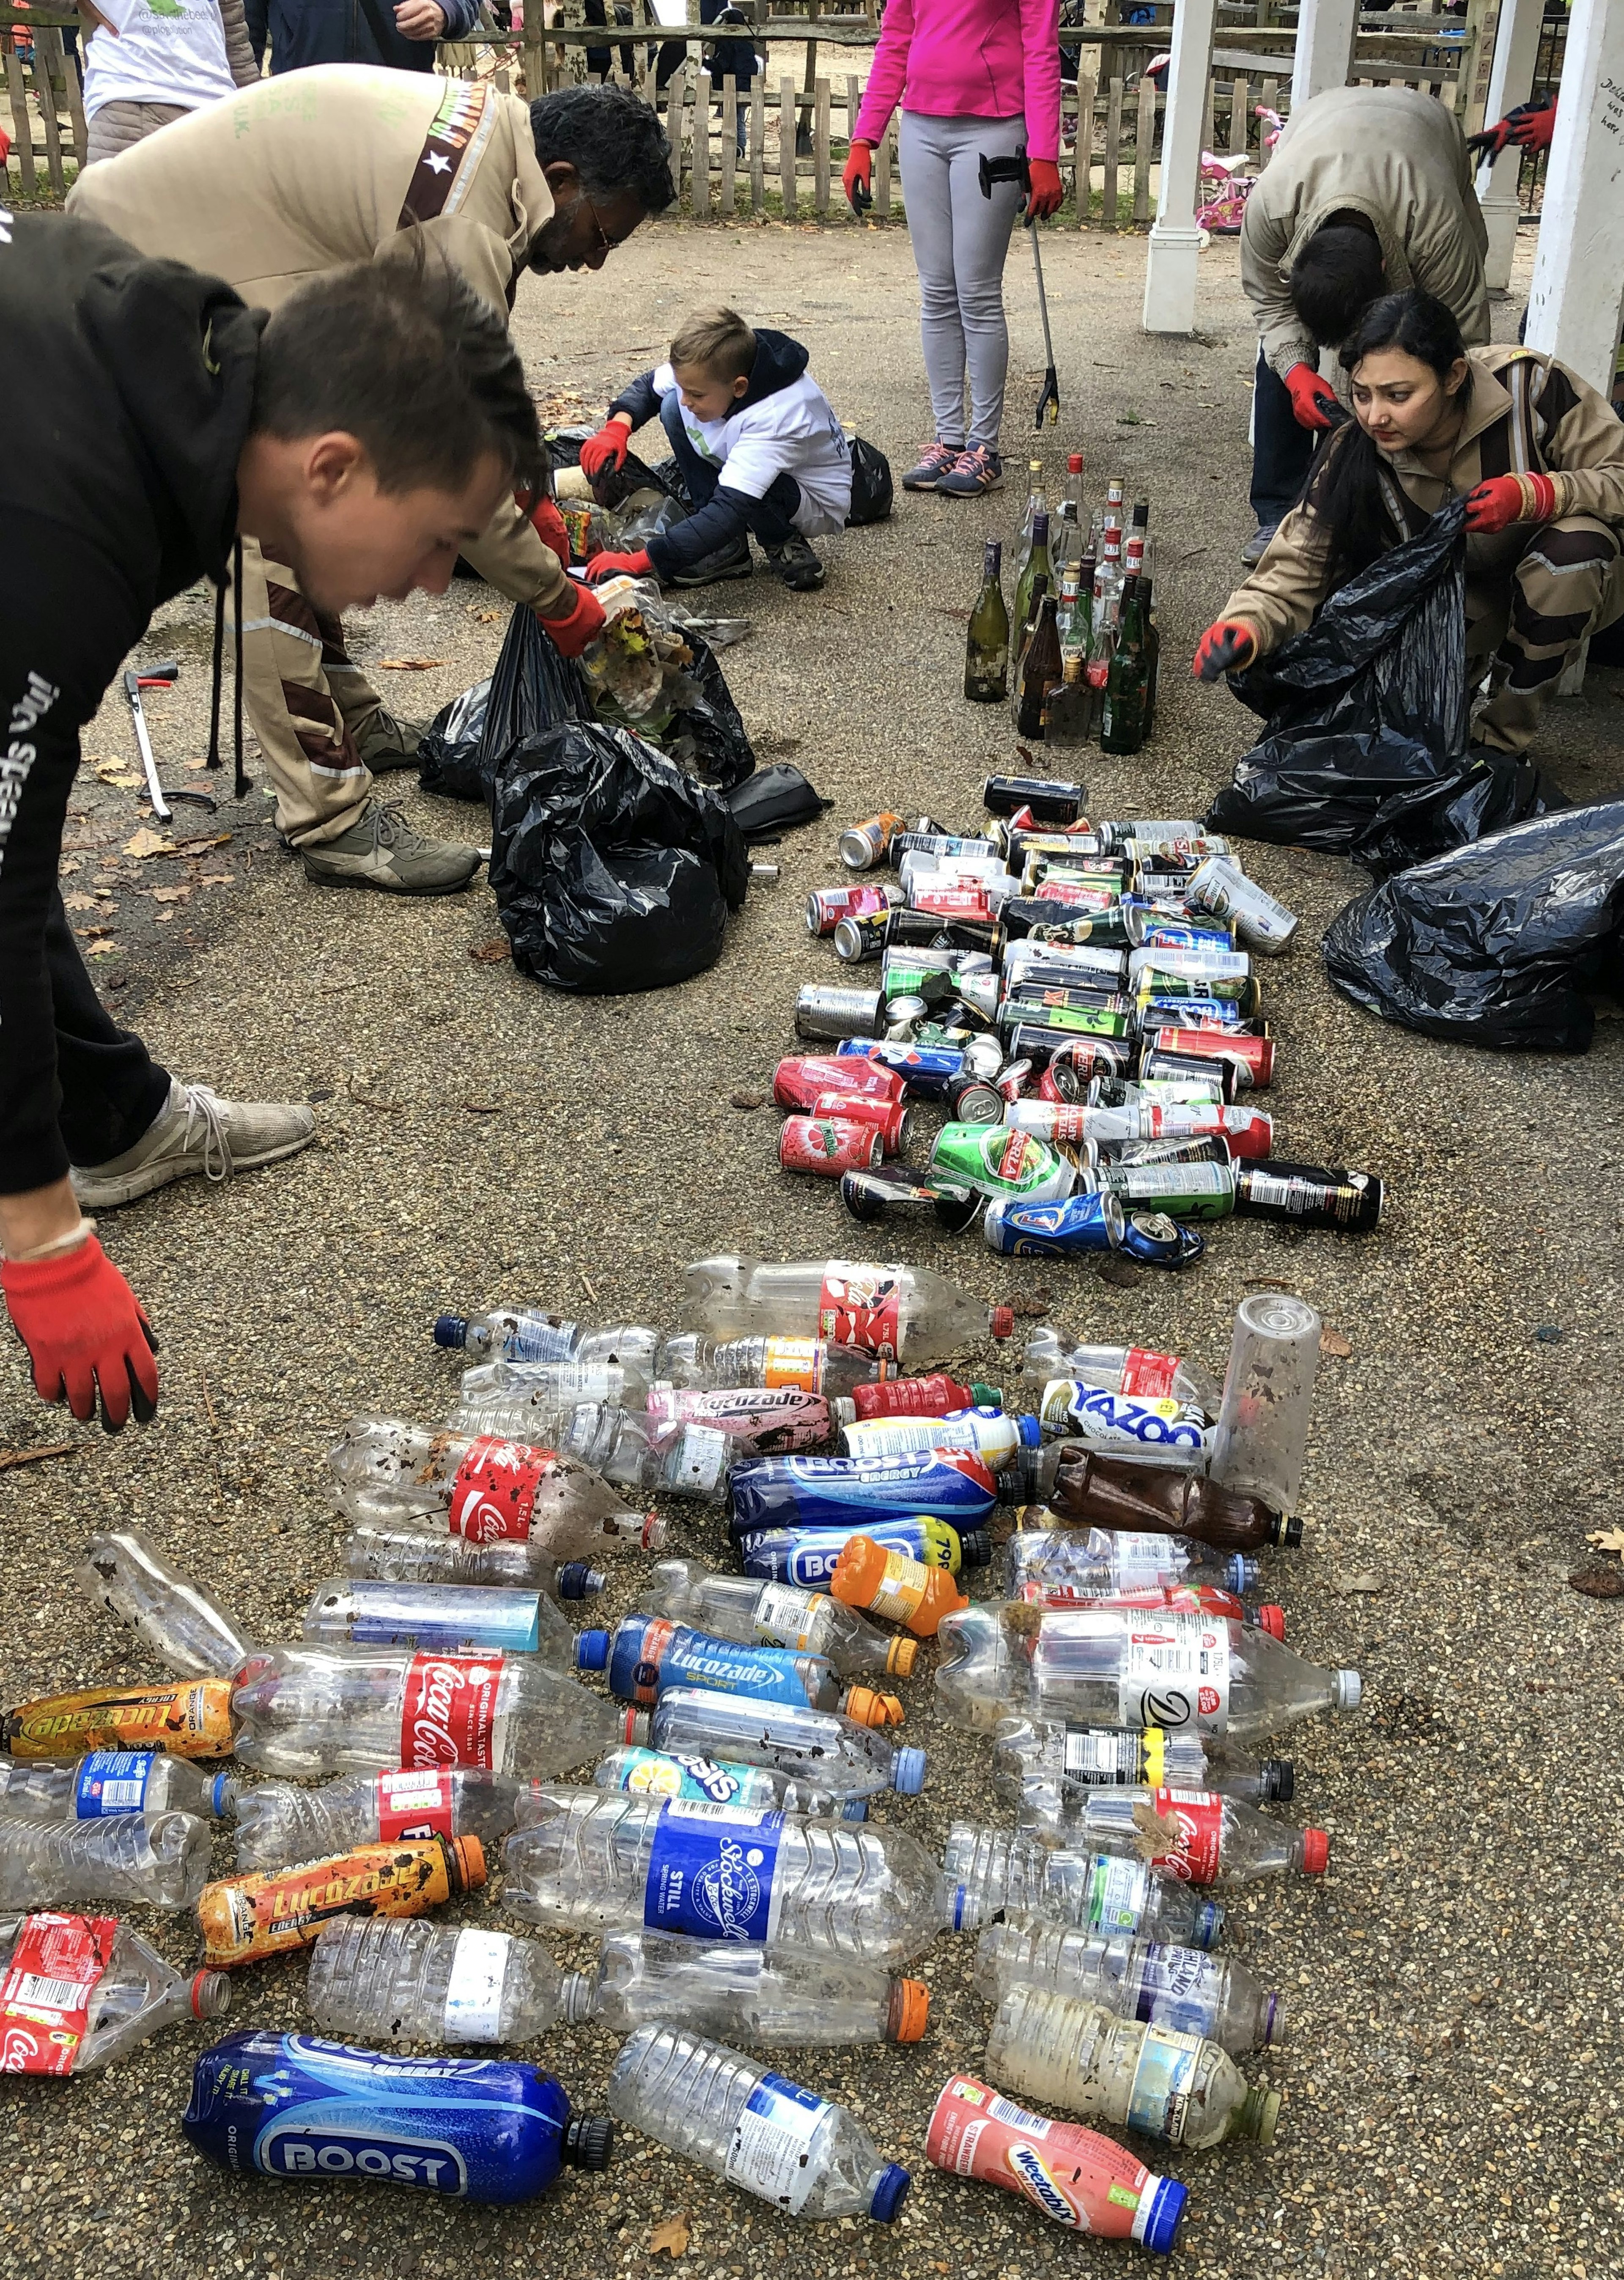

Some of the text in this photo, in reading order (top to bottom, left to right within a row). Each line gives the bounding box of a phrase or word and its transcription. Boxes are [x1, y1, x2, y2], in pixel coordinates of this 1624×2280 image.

[1607, 101, 1624, 118] was
[693, 1393, 804, 1410] Lucozade
[1062, 1410, 1068, 1423] NO
[1074, 1381, 1202, 1448] YAZOO
[801, 1450, 922, 1472] BOOST
[860, 1467, 921, 1483] ENERGY
[669, 1647, 768, 1684] Lucozade
[685, 1671, 738, 1690] SPORT
[138, 1694, 178, 1704] ENERGY
[188, 1688, 197, 1731] ORANGE
[479, 1682, 492, 1733] ORIGINAL
[34, 1704, 172, 1739] Lucozade
[677, 1751, 741, 1804] asis
[1209, 1830, 1218, 1873] ORIGINAL
[272, 1860, 417, 1918] Lucozade
[657, 1864, 670, 1915] SPRING WATER
[667, 1871, 684, 1911] STILL
[719, 1837, 750, 1941] Stockwell
[236, 1889, 252, 1939] ORANGE
[271, 1914, 313, 1933] ENERGY
[228, 2125, 240, 2173] ORIGINAL
[283, 2143, 447, 2187] BOOST
[728, 2147, 741, 2170] 500ml
[785, 2140, 806, 2193] Natural mineral
[1016, 2150, 1077, 2220] Weetabix
[1018, 2170, 1029, 2183] on
